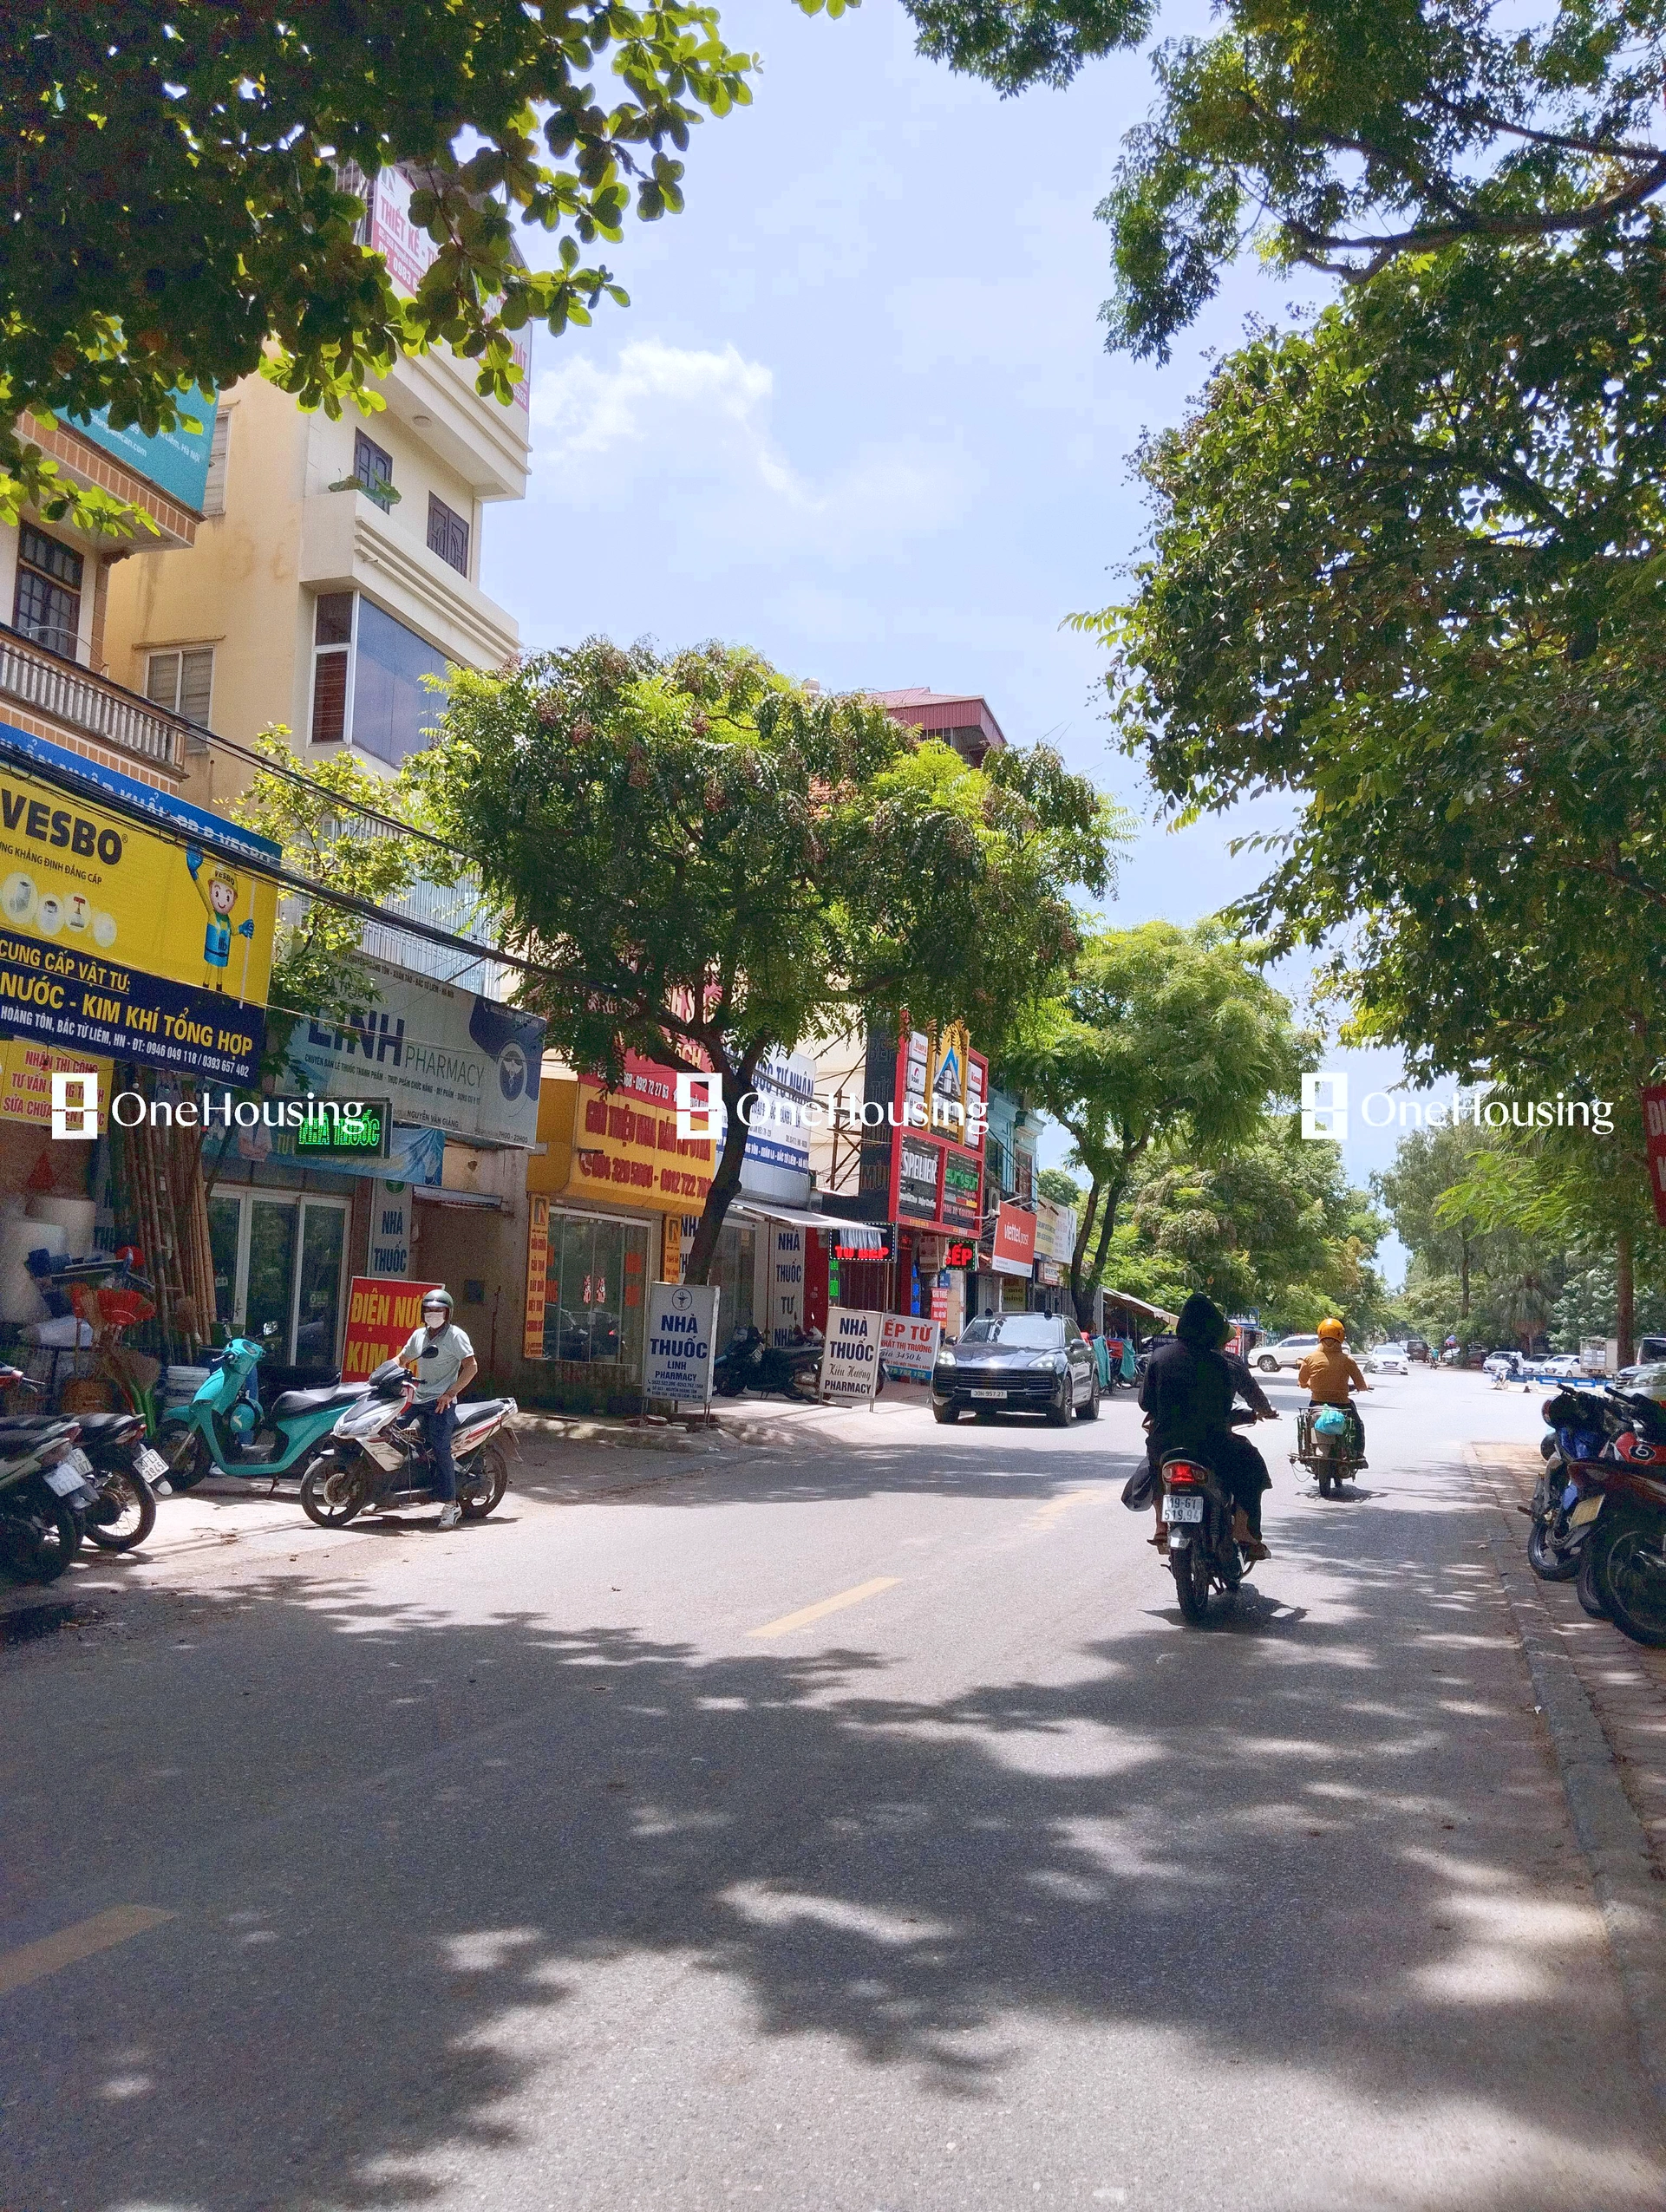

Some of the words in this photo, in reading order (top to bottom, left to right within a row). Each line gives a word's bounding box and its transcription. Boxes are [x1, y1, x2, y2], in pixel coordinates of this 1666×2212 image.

[213, 870, 235, 886] VESBO
[0, 939, 42, 967] CUNG
[44, 950, 75, 975] CẤP
[79, 961, 107, 987] VẬT
[0, 971, 65, 1009] NƯỚC
[82, 993, 121, 1024] KIM
[126, 1005, 160, 1034] KHÍ
[164, 1007, 213, 1047] TỔNG
[217, 1029, 253, 1060] HỢP
[1, 1005, 33, 1026] HOÀNG
[56, 1016, 75, 1035] BẮC
[113, 1033, 127, 1048] HN
[146, 1041, 166, 1057] 0946
[167, 1046, 182, 1061] 049
[183, 1050, 197, 1065] 118
[202, 1054, 220, 1072] 0393
[221, 1060, 235, 1073] 657
[235, 1063, 250, 1078] 402
[56, 1056, 70, 1073] THI
[404, 1045, 485, 1088] PHARMACY
[12, 1073, 26, 1088] TƯ
[27, 1073, 47, 1093] VẤN
[3, 1093, 23, 1113] SỬA
[27, 1100, 52, 1119] CHỮA
[382, 1206, 403, 1235] NHÀ
[778, 1230, 800, 1251] NHÀ
[374, 1241, 408, 1273] THUỐC
[776, 1258, 801, 1283] THUỐC
[350, 1287, 390, 1333] ĐIỆN
[781, 1295, 795, 1315] TƯ
[661, 1313, 698, 1334] NHÀ
[839, 1316, 867, 1336] NHÀ
[911, 1324, 933, 1341] TỪ
[347, 1341, 389, 1374] KIM
[650, 1336, 708, 1360] THUỐC
[830, 1338, 873, 1361] THUỐC
[655, 1370, 697, 1381] PHARMACY
[667, 1360, 687, 1370] LINH
[824, 1380, 872, 1394] PHARMACY
[145, 1463, 165, 1479] 3945
